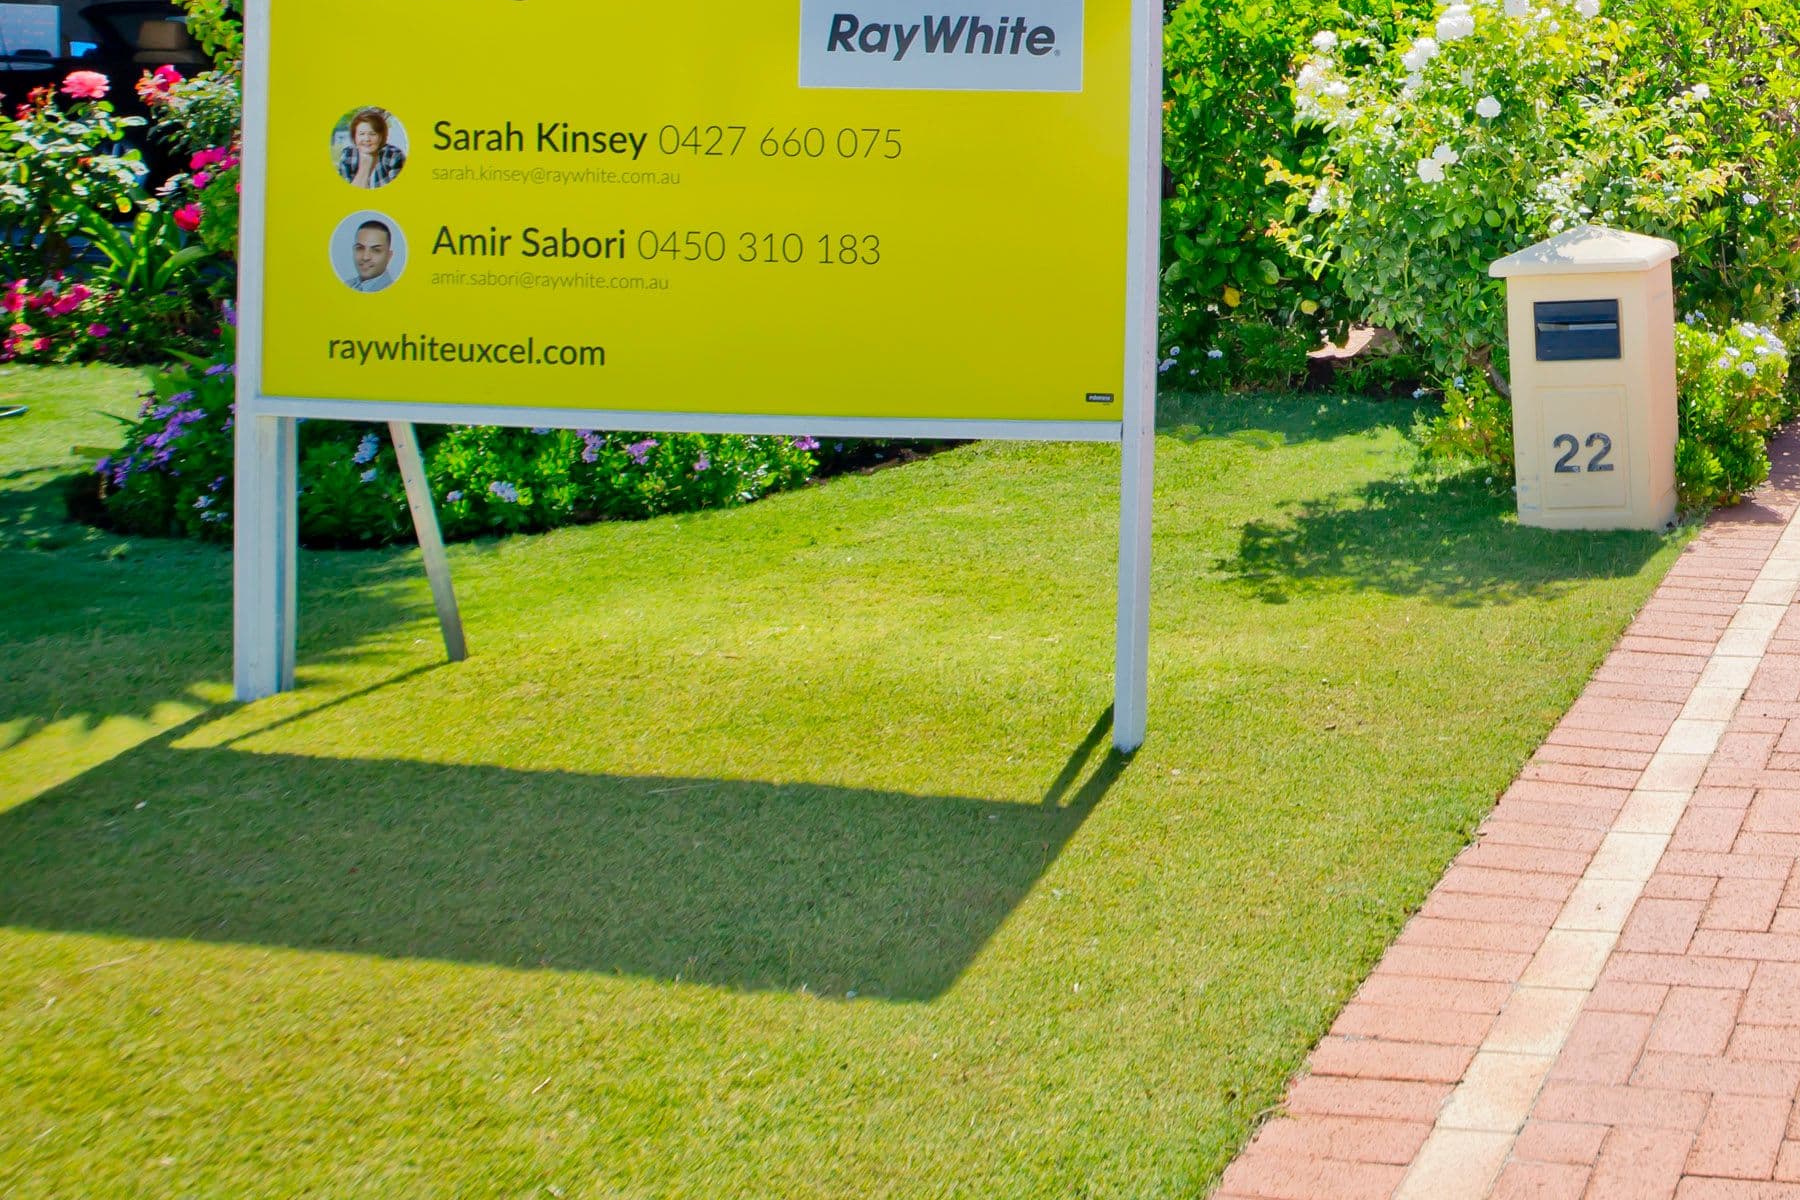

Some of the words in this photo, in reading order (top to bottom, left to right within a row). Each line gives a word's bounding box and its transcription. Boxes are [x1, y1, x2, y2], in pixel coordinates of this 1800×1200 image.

[433, 120, 524, 153] Sarah
[537, 122, 648, 161] Kinsey
[658, 124, 747, 157] 0427
[759, 126, 825, 158] 660
[836, 127, 902, 160] 075
[431, 165, 681, 186] sarah.kinsey@raywhite.com.au
[431, 225, 512, 257] Amir
[521, 226, 626, 260] Sabori
[637, 229, 726, 262] 0450
[737, 231, 804, 264] 310
[817, 233, 881, 266] 183
[431, 270, 669, 291] amir.sabori@raywhite.com.au
[328, 333, 606, 367] raywhiteuxcel.com
[1552, 432, 1615, 474] 22
